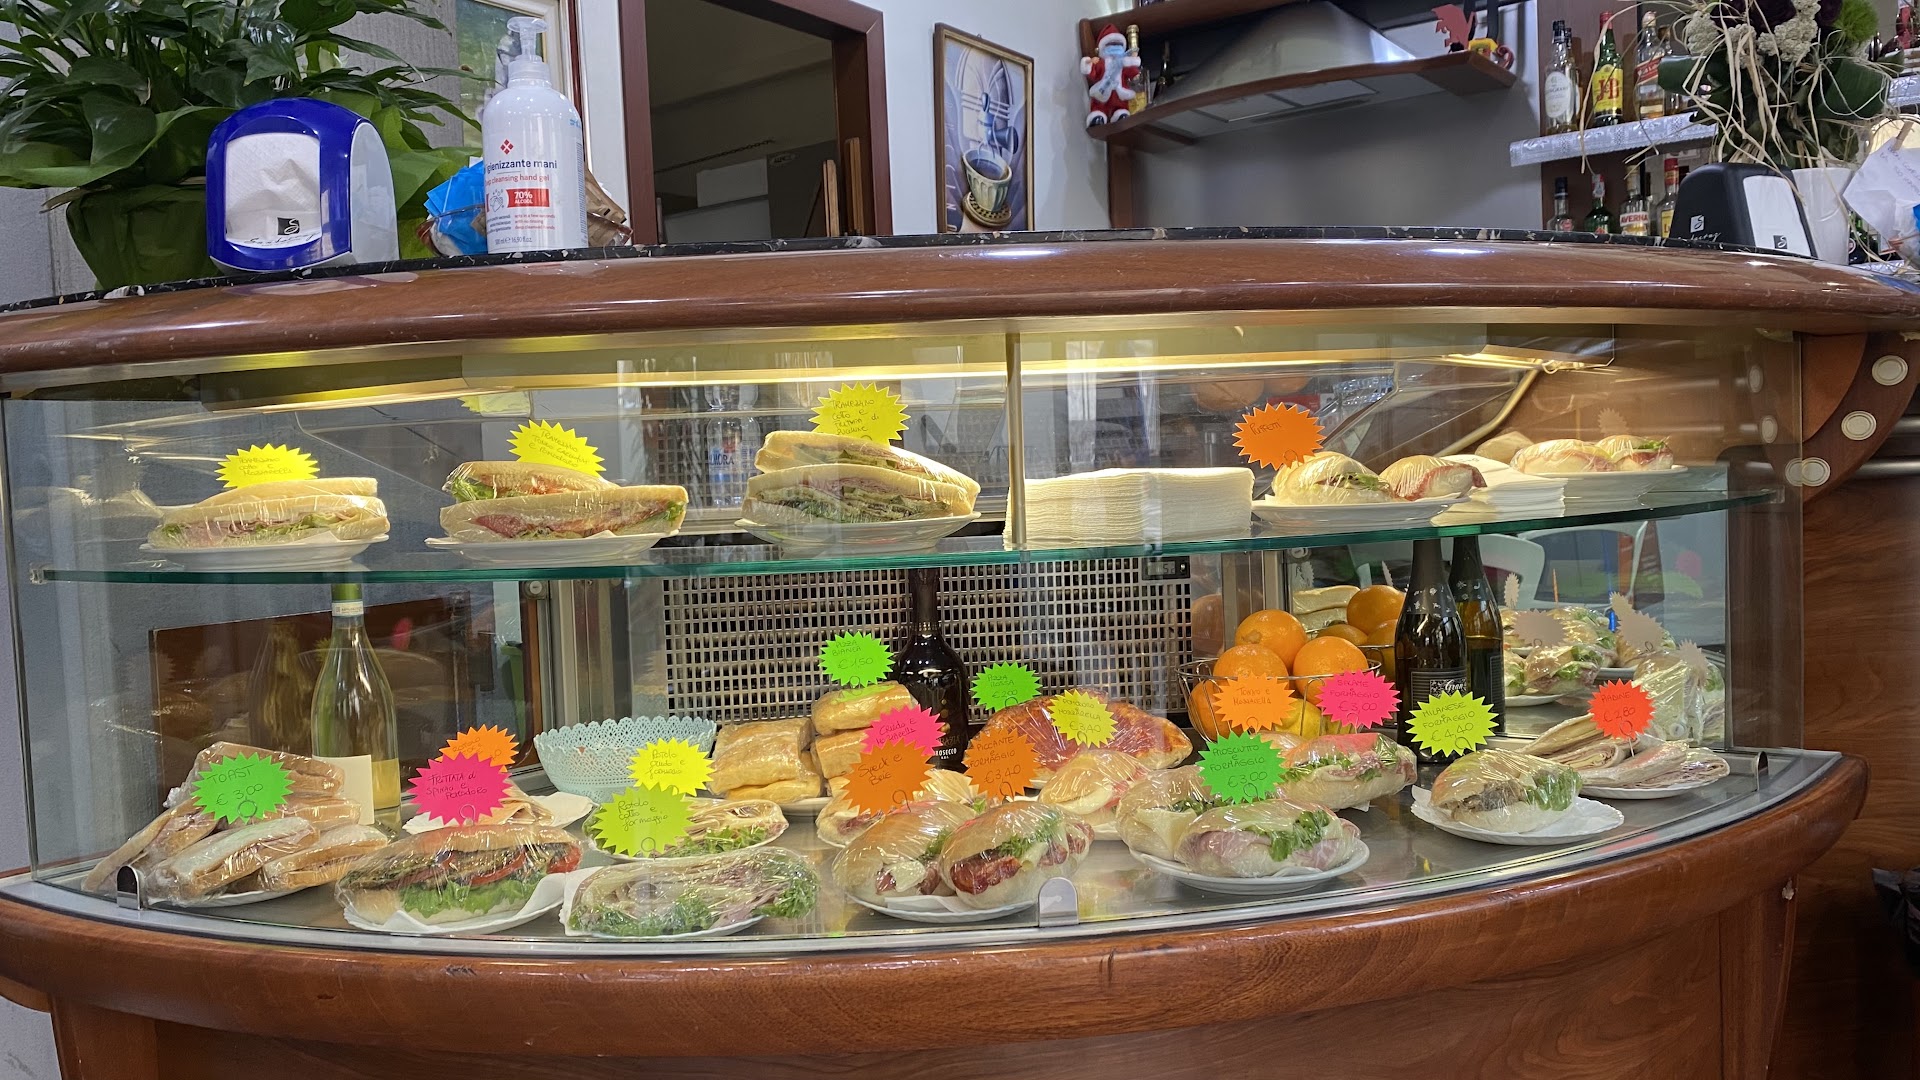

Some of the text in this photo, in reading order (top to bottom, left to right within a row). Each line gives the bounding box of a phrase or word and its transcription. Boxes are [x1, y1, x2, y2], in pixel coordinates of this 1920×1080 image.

[533, 160, 557, 169] mani
[519, 173, 537, 181] hand
[514, 191, 533, 199] 70%
[1620, 212, 1649, 224] AVERNA
[1329, 689, 1380, 699] FORMAGGIO
[1058, 708, 1102, 721] MOZZARELLA
[1422, 701, 1467, 718] MILANESE
[1423, 710, 1475, 728] FORMAGGIO
[977, 736, 1015, 751] PICCANTE
[934, 748, 957, 756] ROSECCO
[1212, 745, 1259, 756] PROSCIUTTO
[970, 750, 1016, 768] FORMAGGIO
[1210, 757, 1265, 772] FORMAGGIO
[206, 764, 255, 784] TOAST
